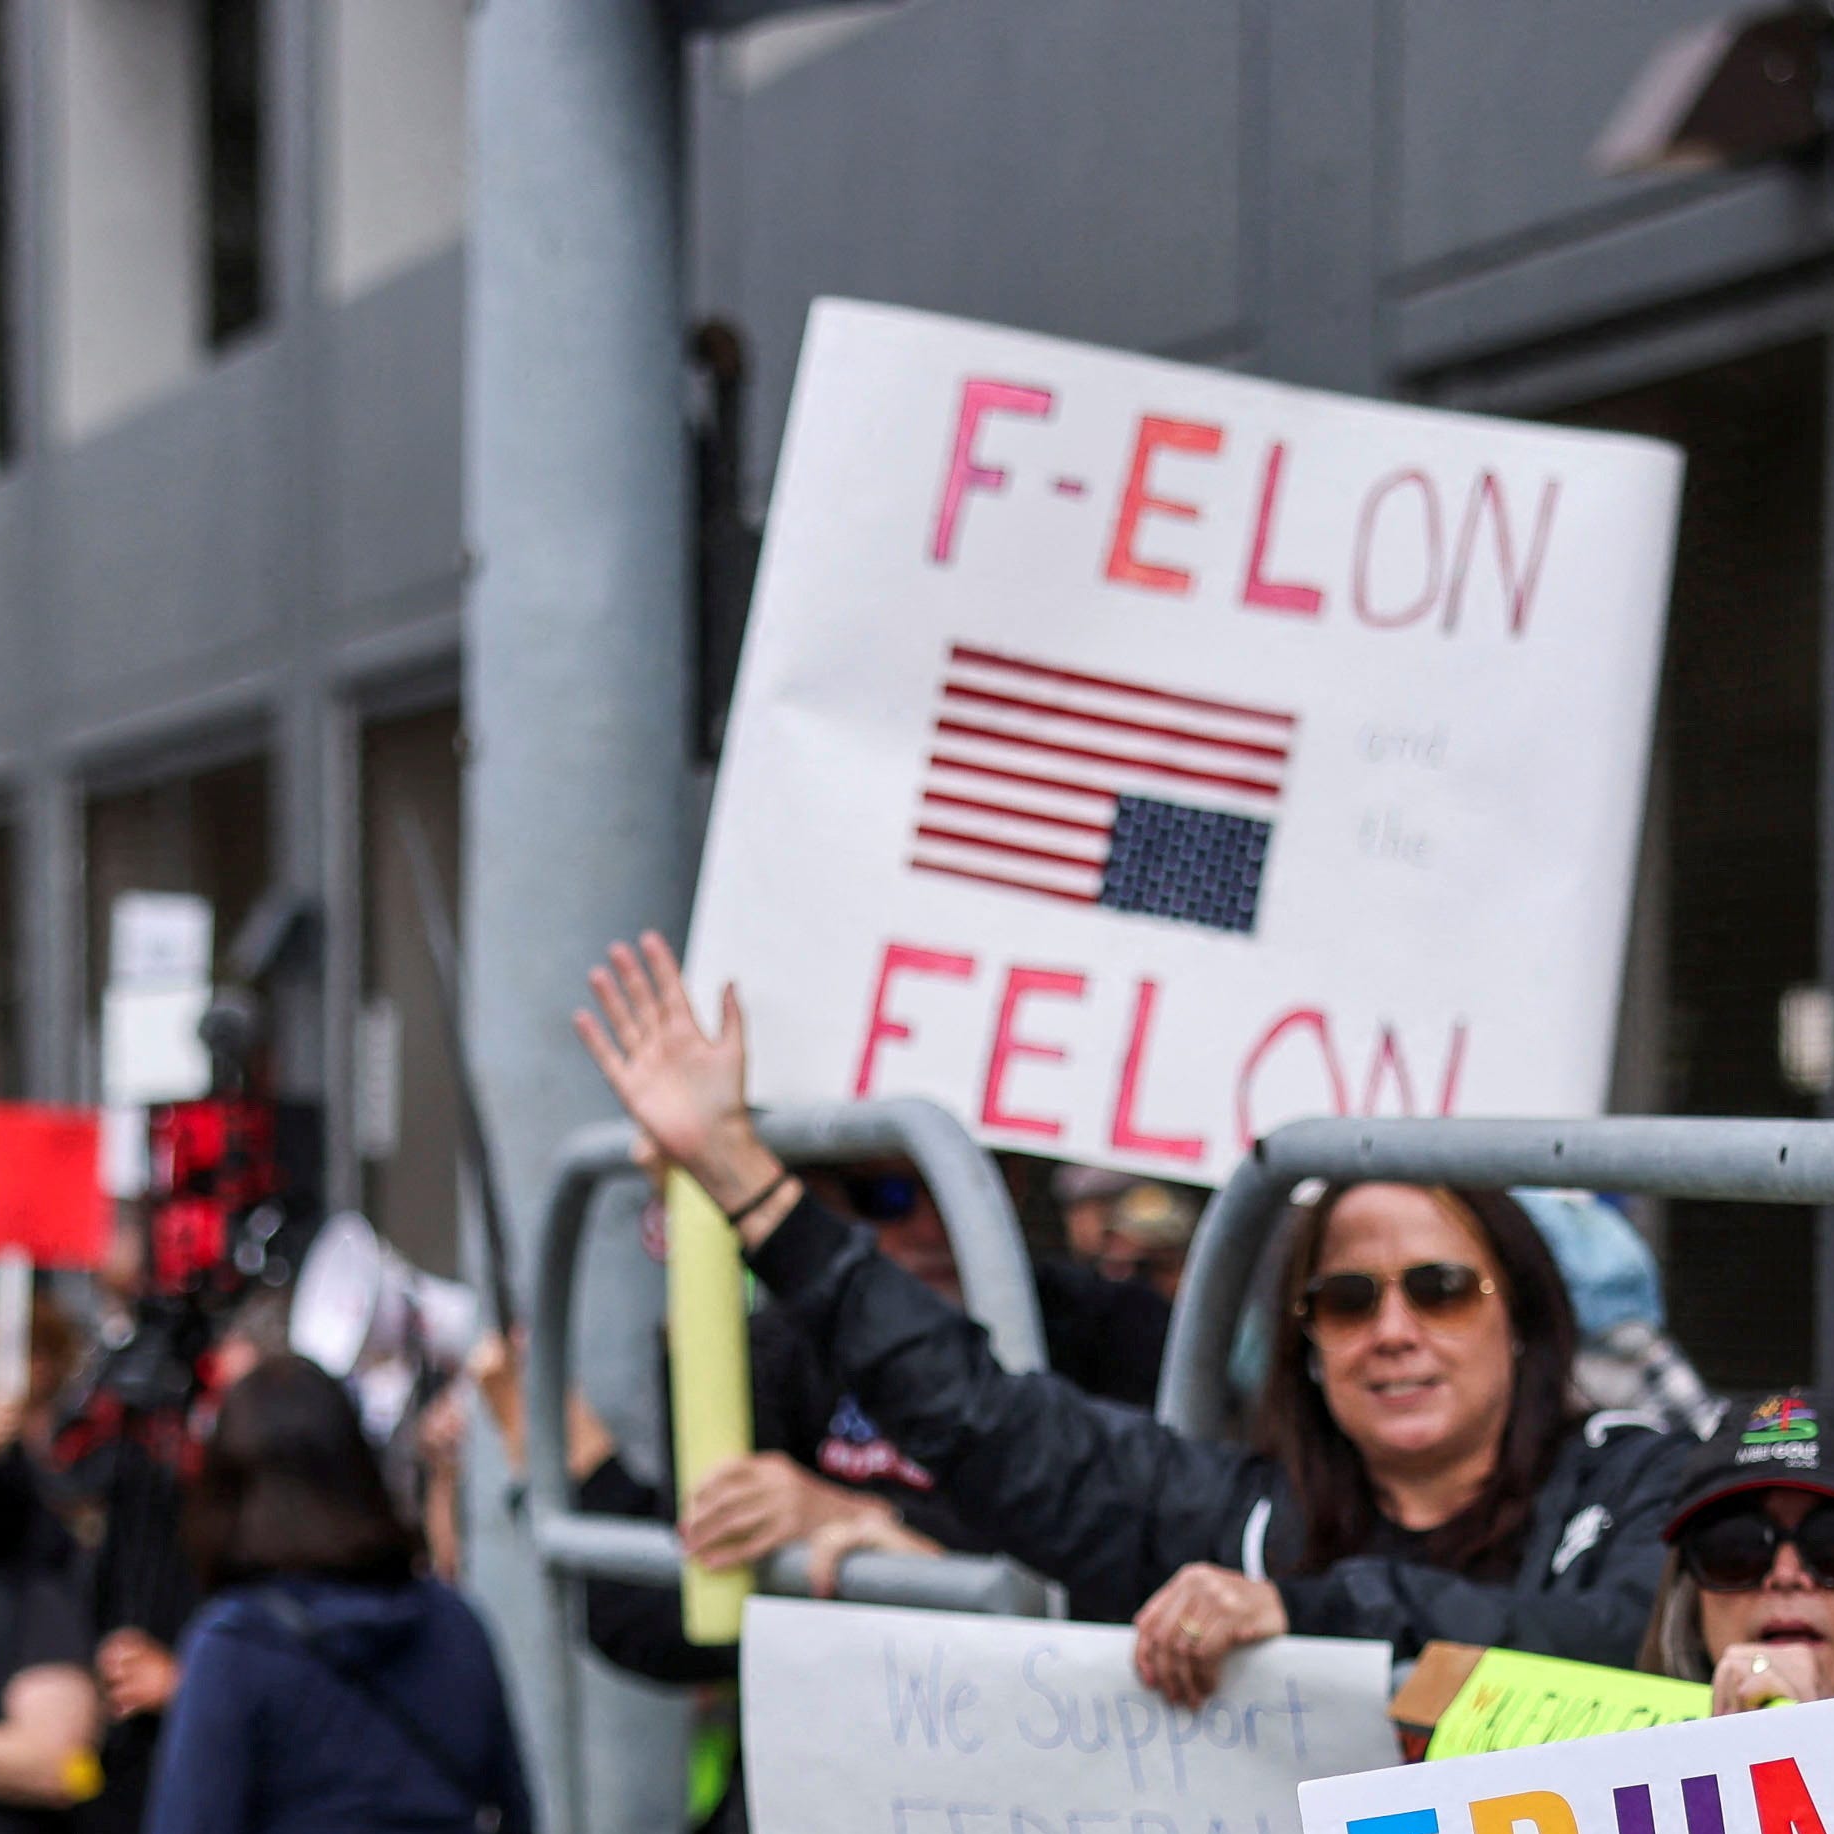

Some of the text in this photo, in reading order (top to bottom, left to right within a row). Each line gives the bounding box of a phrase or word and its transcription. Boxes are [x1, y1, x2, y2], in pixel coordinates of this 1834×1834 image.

[934, 380, 1562, 637] F-ELON
[853, 943, 1469, 1161] FELON
[882, 1635, 1315, 1794] We Support
